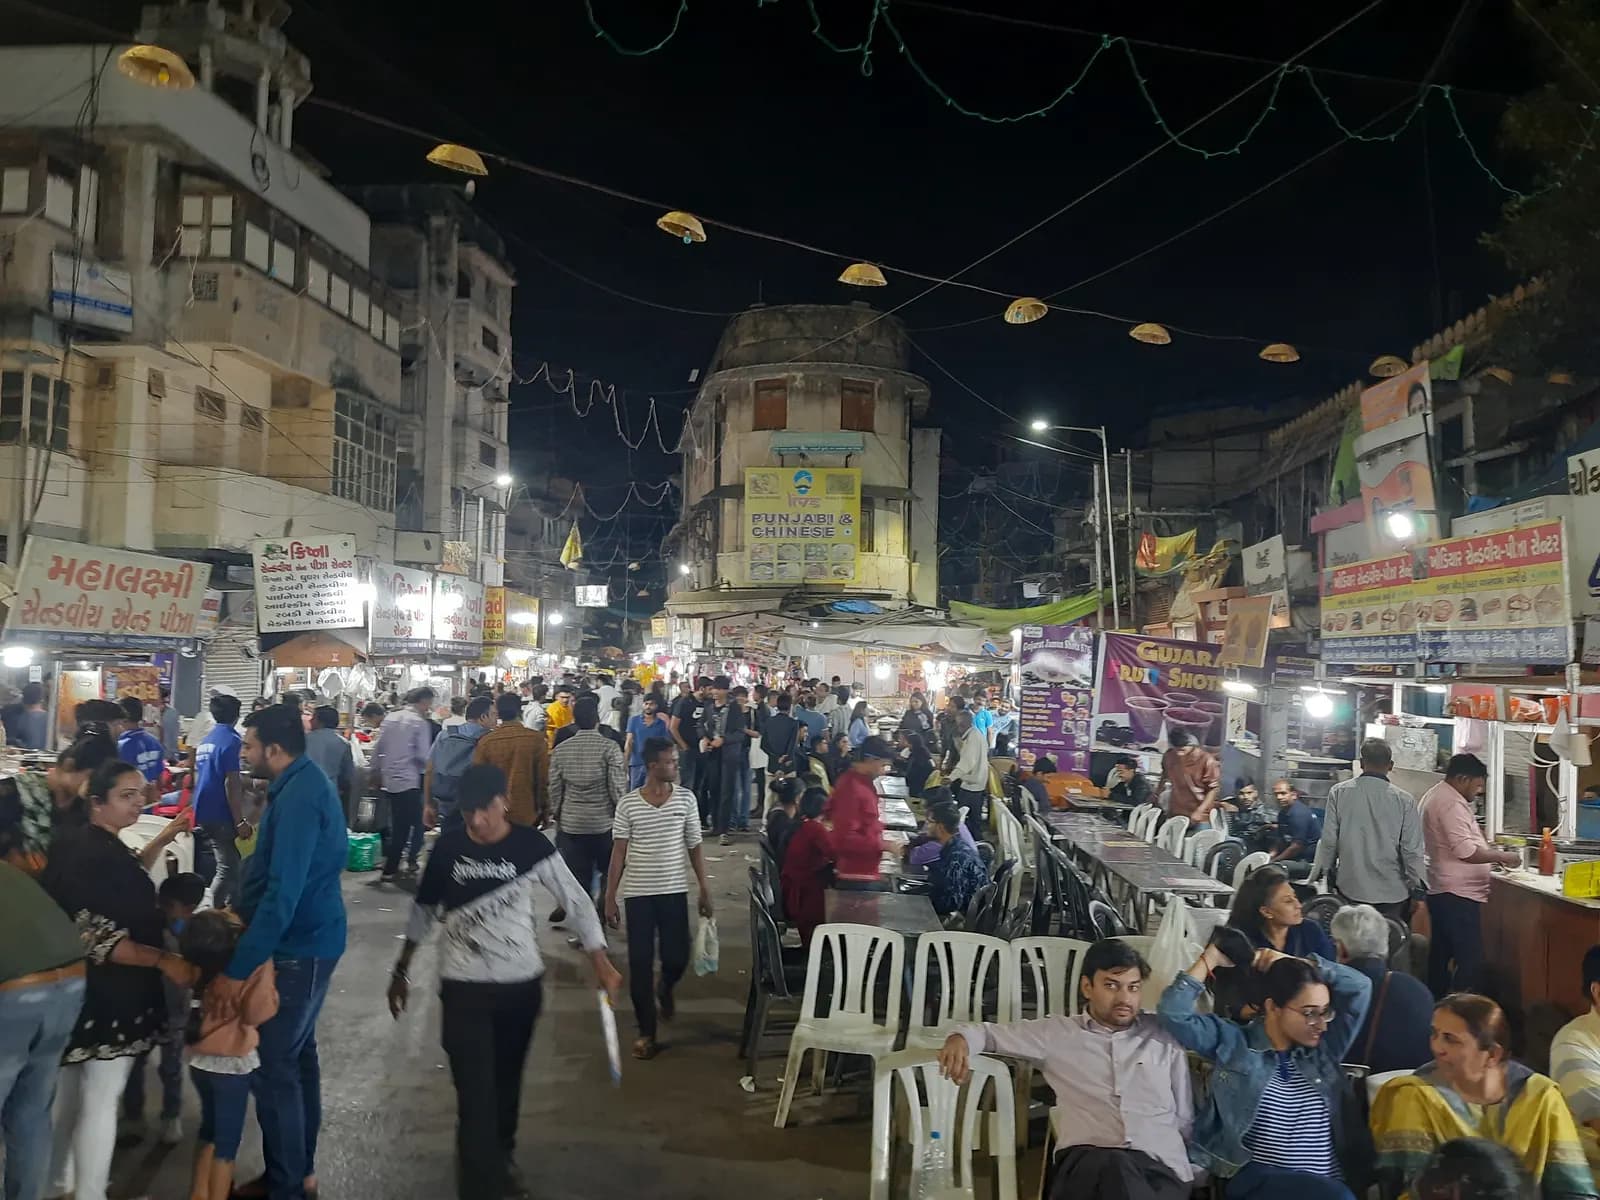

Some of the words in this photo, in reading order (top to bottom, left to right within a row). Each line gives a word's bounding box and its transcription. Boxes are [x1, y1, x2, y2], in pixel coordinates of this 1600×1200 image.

[752, 514, 834, 525] PUNJABI
[838, 514, 853, 525] &
[752, 526, 835, 538] CHINESE
[47, 555, 194, 600] મહાલક્ષ્મી
[20, 588, 104, 628] સેન્ડવીચ
[485, 596, 502, 615] ad
[484, 617, 502, 629] izza
